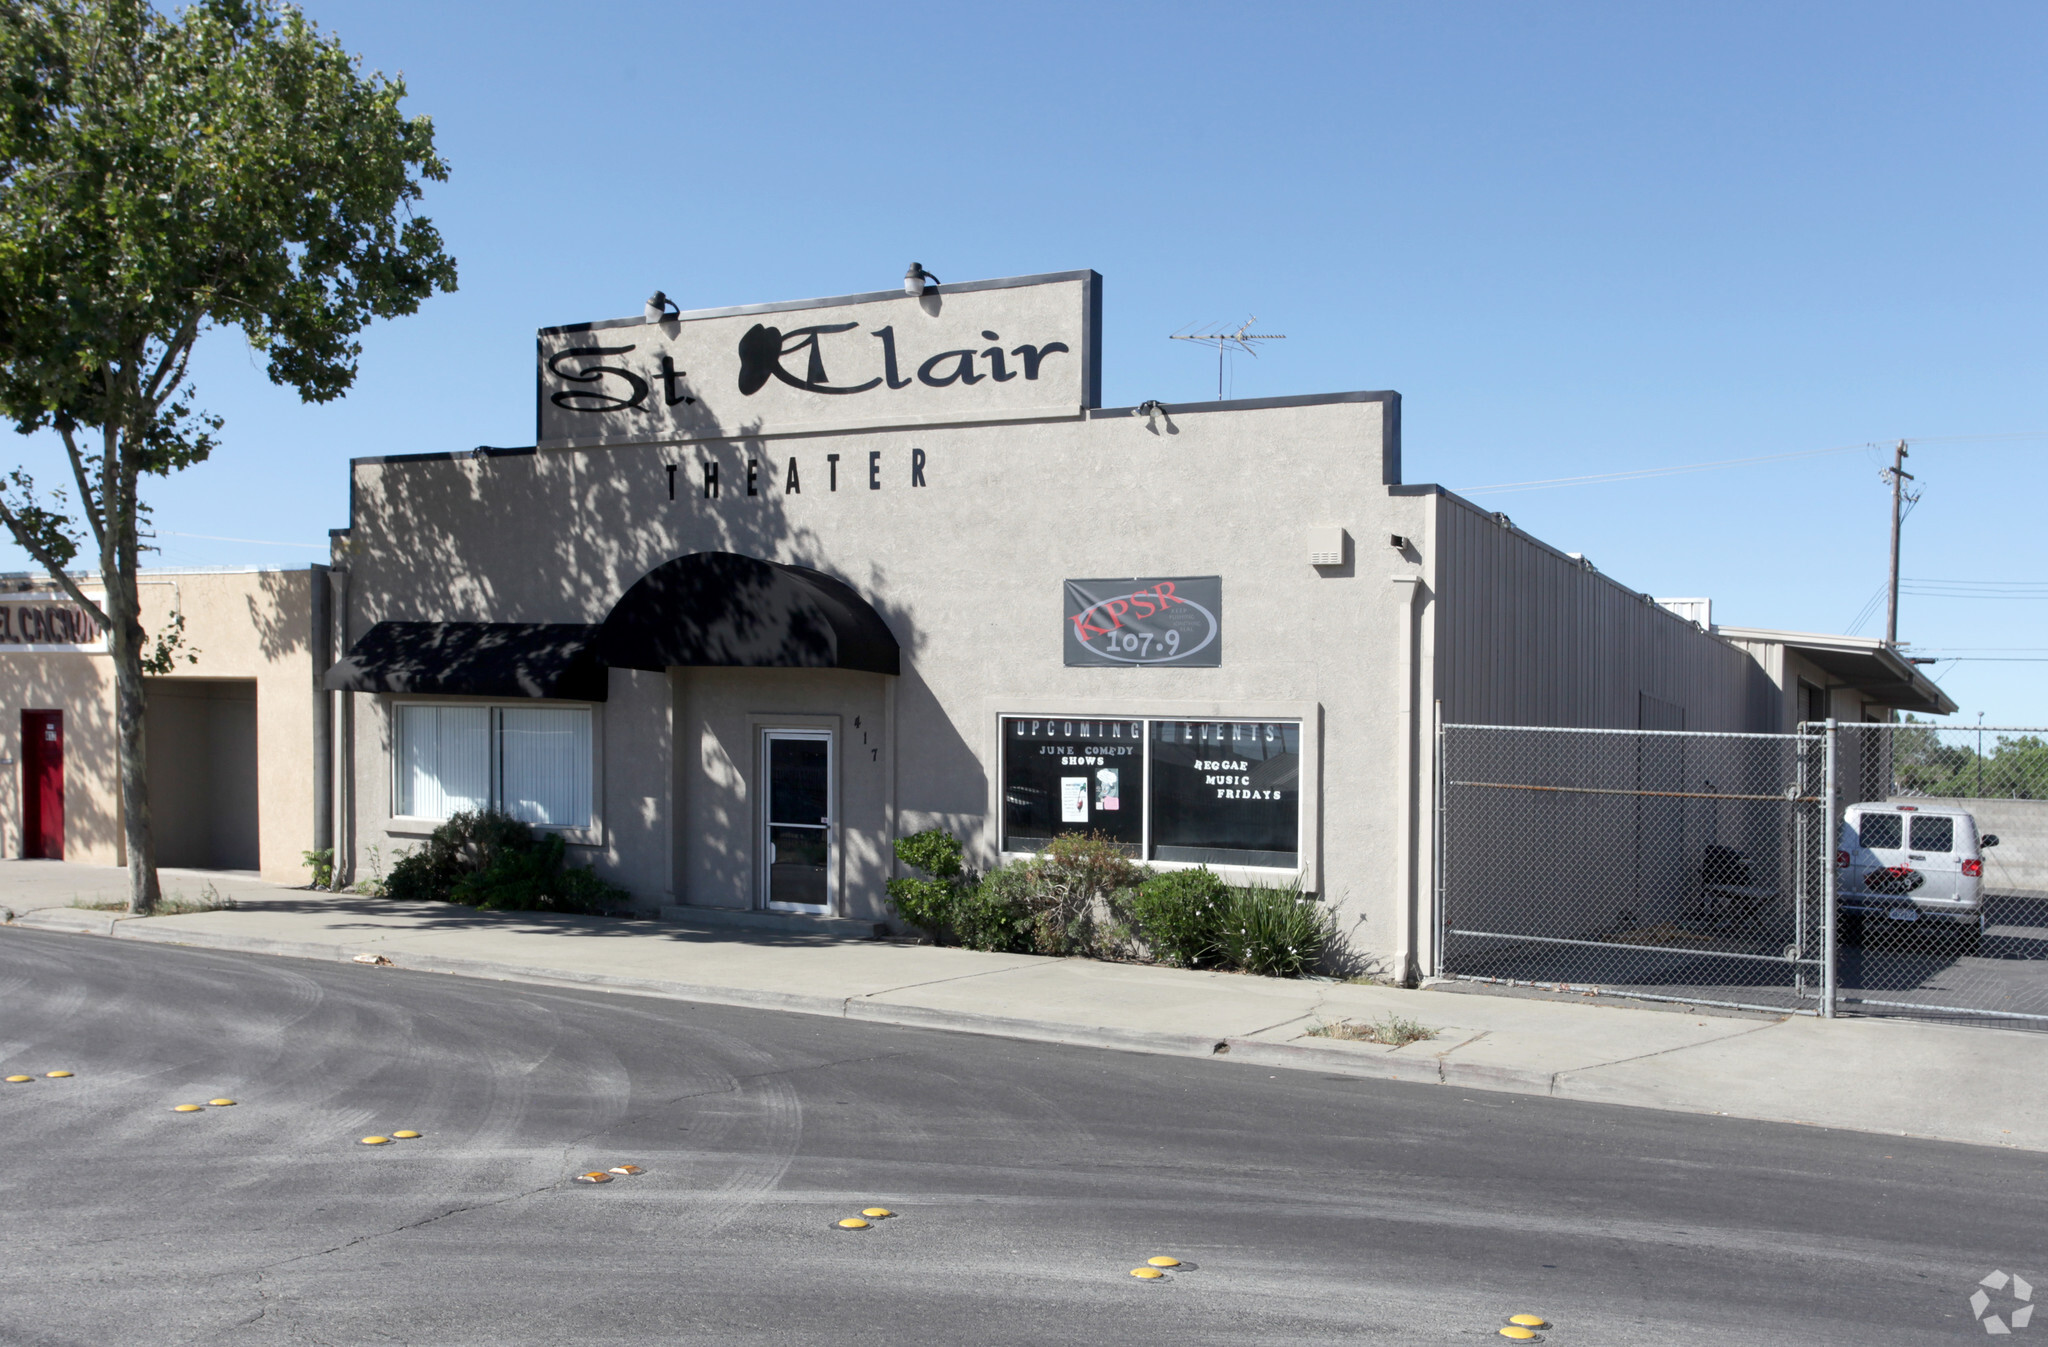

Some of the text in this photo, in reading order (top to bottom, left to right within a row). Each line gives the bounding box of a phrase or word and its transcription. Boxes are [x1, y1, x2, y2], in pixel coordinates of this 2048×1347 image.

[549, 343, 697, 414] St.
[665, 447, 927, 500] THEATER
[1067, 581, 1188, 643] KPSR
[1106, 629, 1180, 657] 107.9
[1016, 719, 1275, 742] UPCOMING EVENTS
[1039, 745, 1134, 756] JUNE COMEDY
[1061, 756, 1105, 766] SHOWS
[1193, 759, 1249, 771] REGGAE
[1205, 774, 1250, 786] MUSIC
[1217, 788, 1281, 800] FRIDAYS
